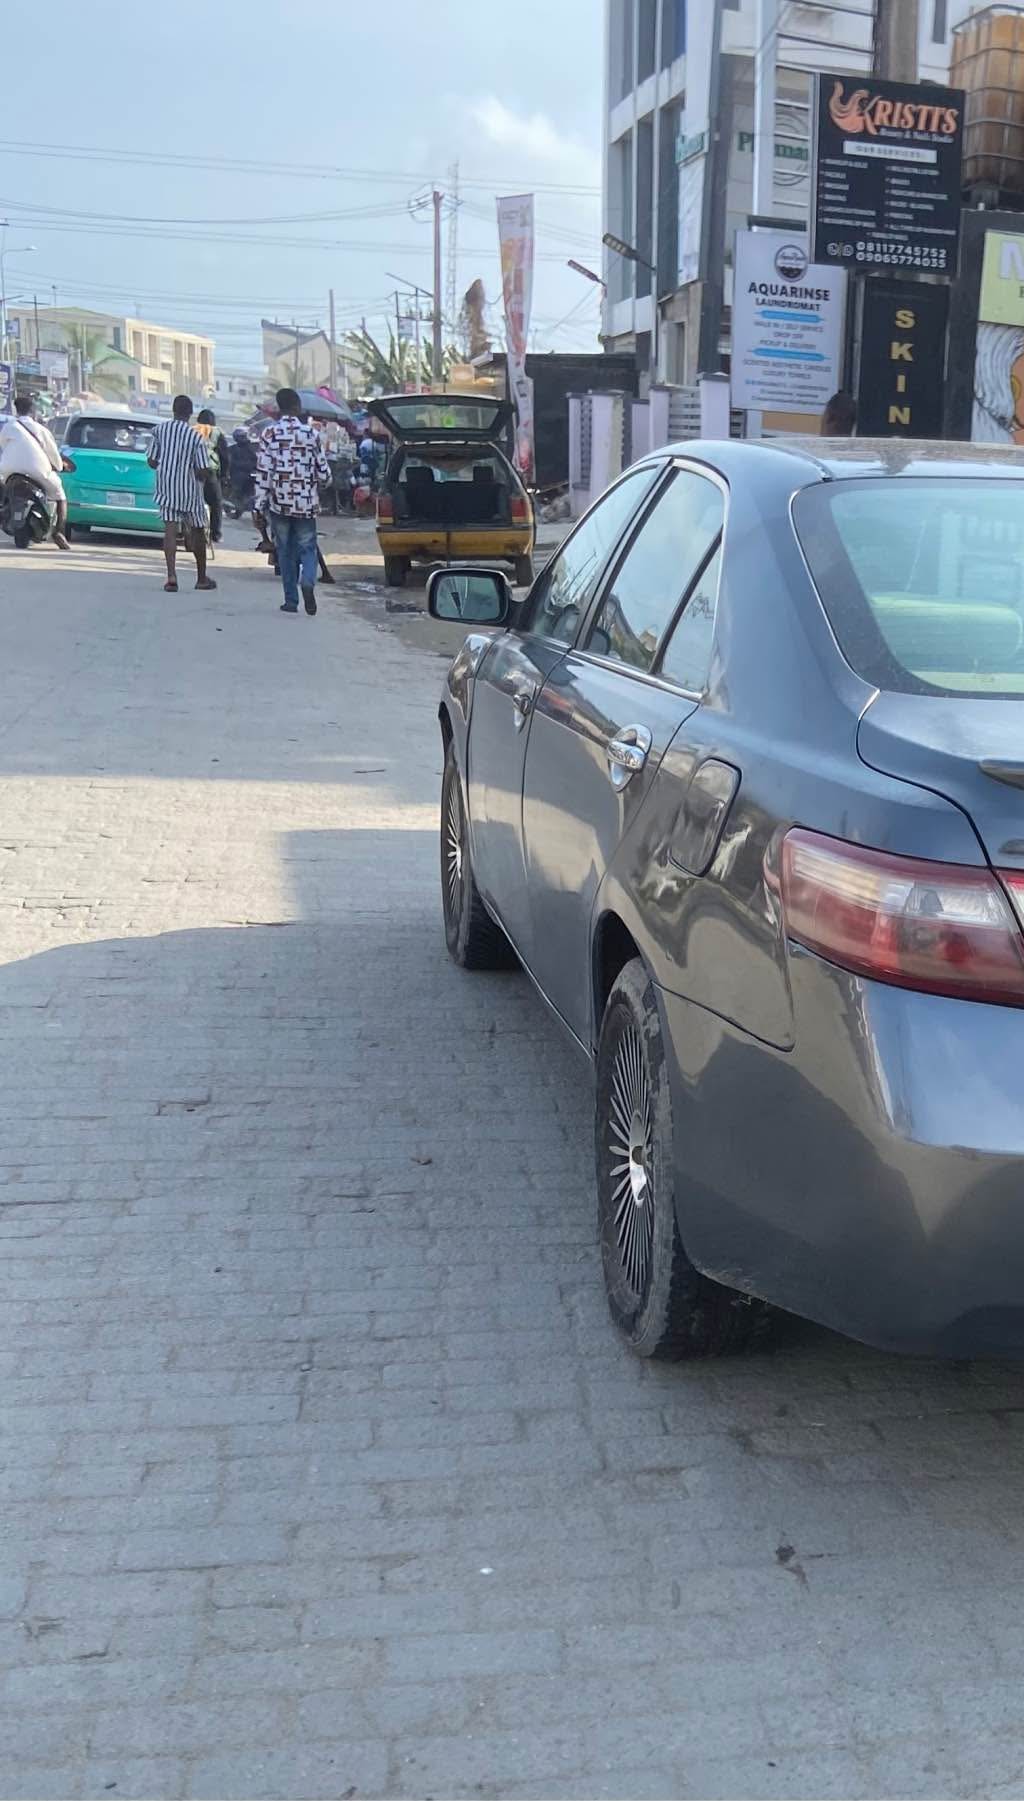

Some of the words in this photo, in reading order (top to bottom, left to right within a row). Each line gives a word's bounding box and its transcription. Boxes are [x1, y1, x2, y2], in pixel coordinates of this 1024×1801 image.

[748, 281, 830, 302] AQUARINSE
[755, 298, 821, 311] LAUNDROMAT
[888, 309, 916, 425] SKIN
